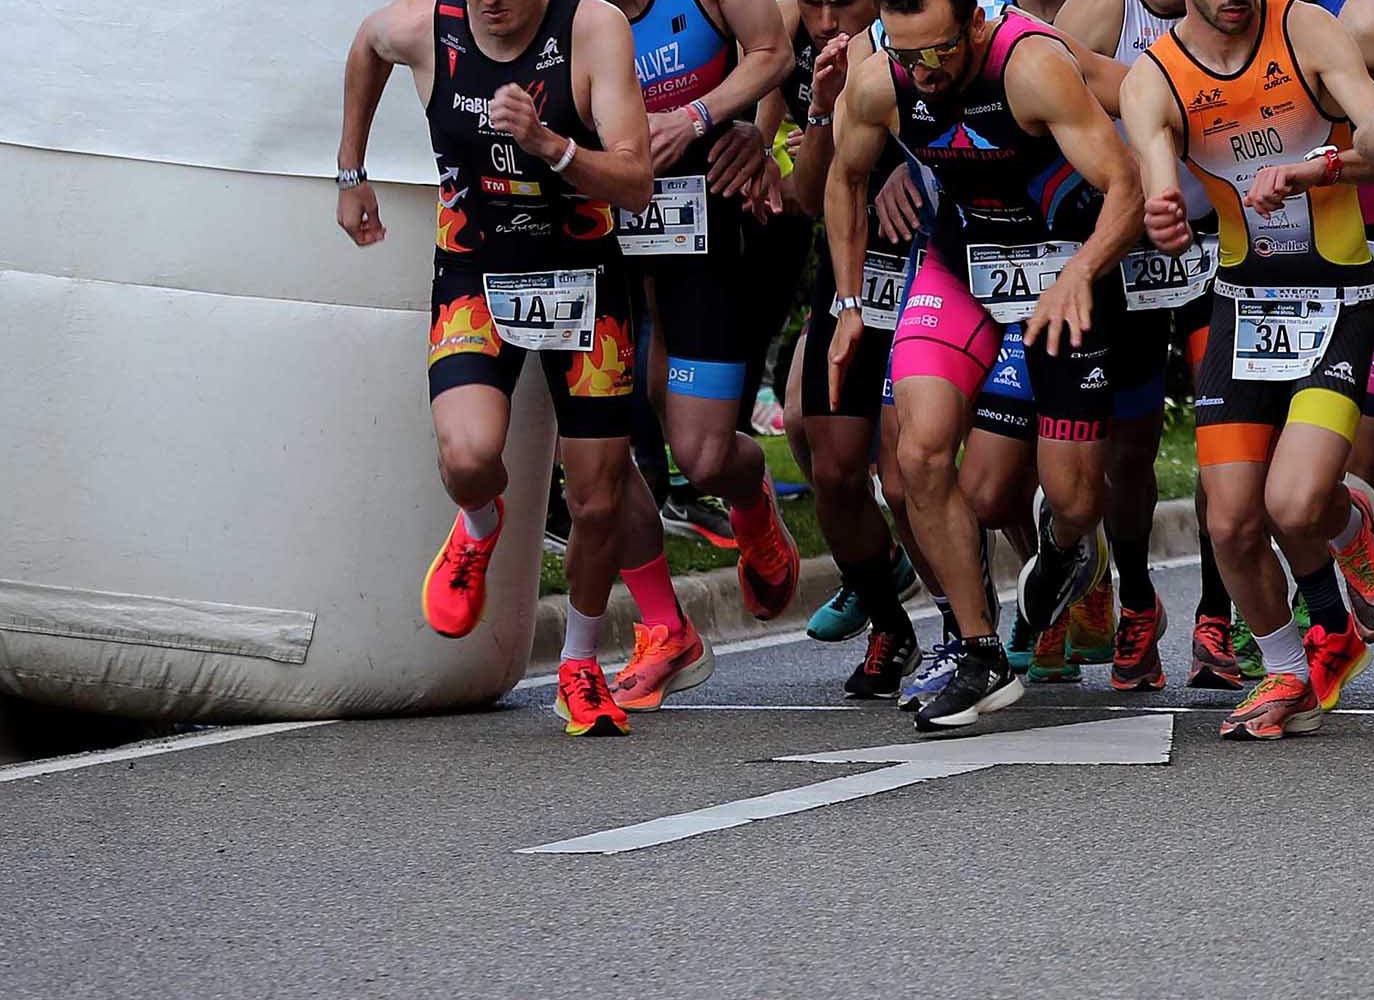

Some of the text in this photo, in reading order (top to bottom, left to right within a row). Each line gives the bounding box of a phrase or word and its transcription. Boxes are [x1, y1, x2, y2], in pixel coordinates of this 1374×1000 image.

[634, 41, 686, 83] ALVEZ
[490, 143, 523, 175] GIL
[1230, 127, 1284, 162] RUBIO
[484, 180, 505, 191] TM
[990, 268, 1031, 297] 2A
[1132, 258, 1187, 286] 29A
[509, 295, 549, 323] 1A
[1255, 324, 1291, 353] 3A
